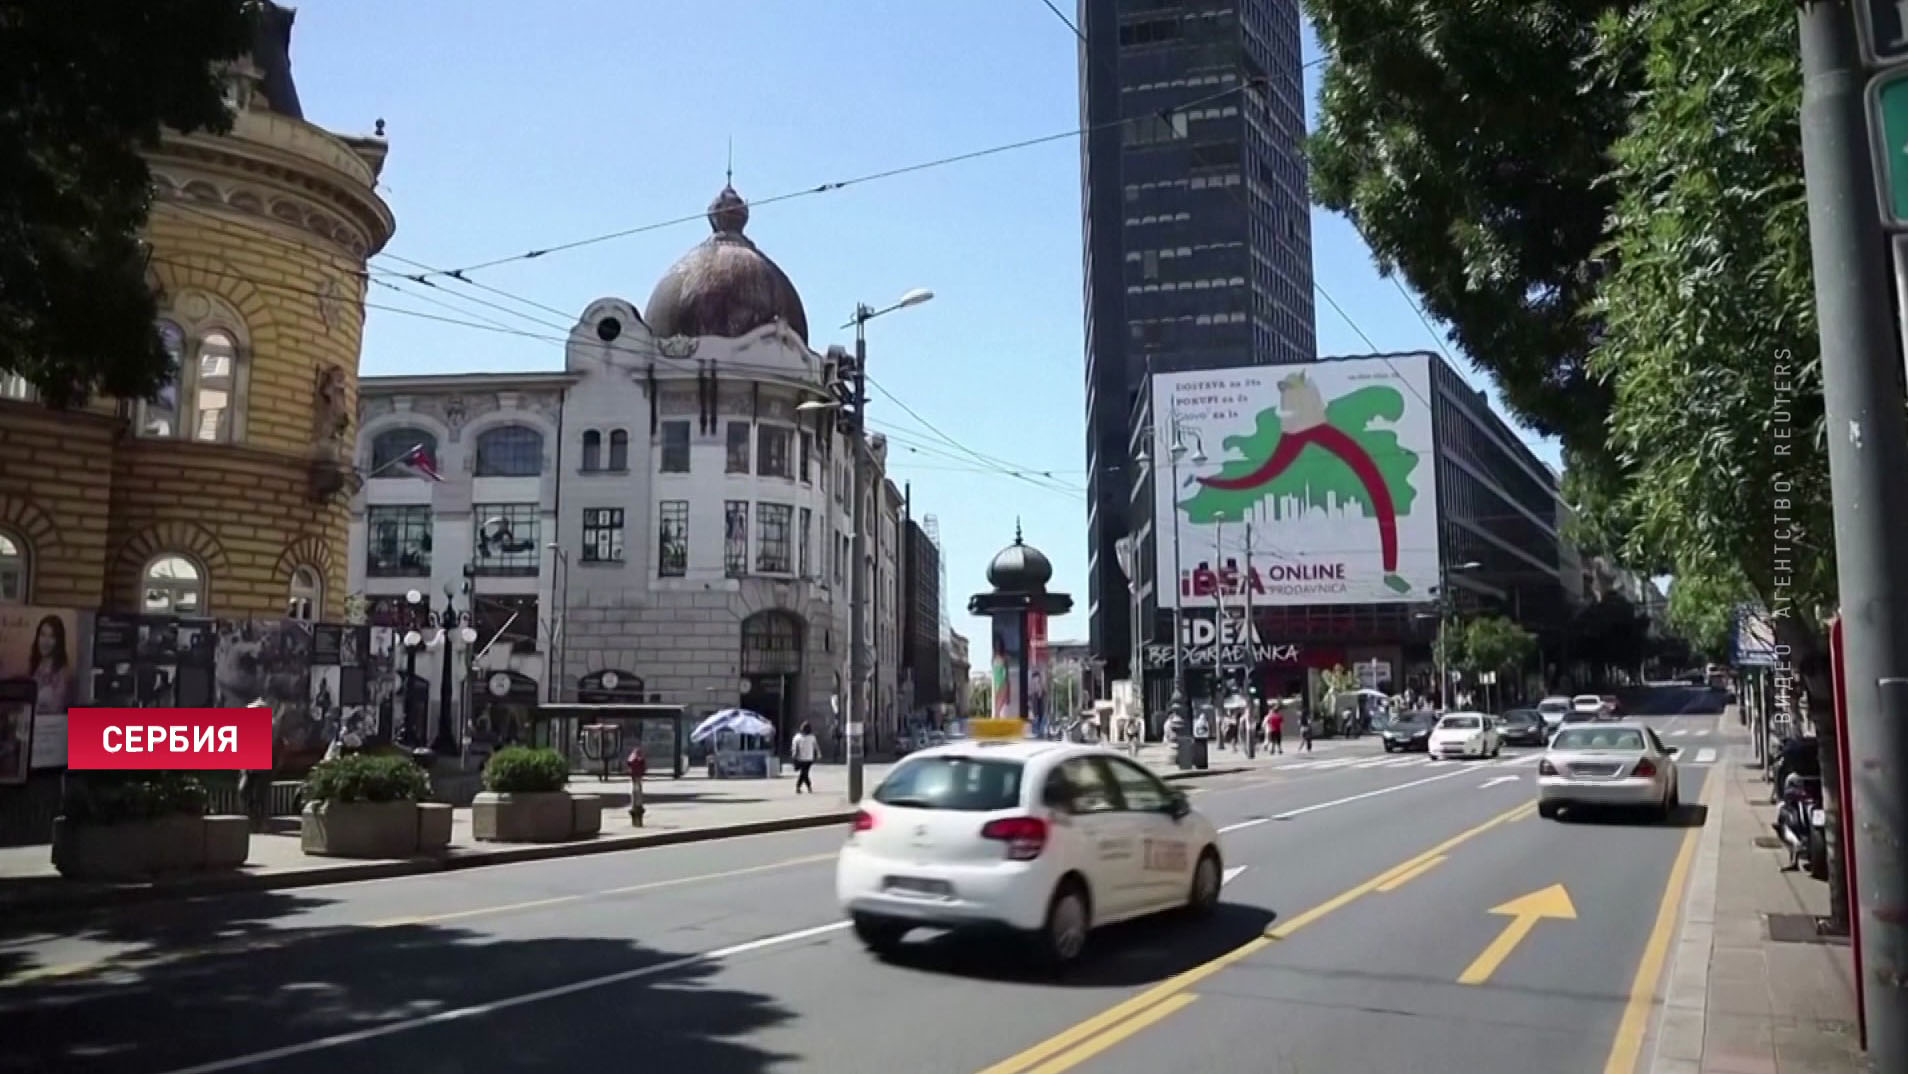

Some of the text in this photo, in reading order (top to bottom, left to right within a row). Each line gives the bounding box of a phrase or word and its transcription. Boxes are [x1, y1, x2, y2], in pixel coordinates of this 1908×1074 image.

[1176, 396, 1218, 405] POKUPI
[1269, 563, 1345, 581] ONLINE
[1269, 582, 1347, 595] PRODAVNICA
[1182, 618, 1262, 645] iDEA
